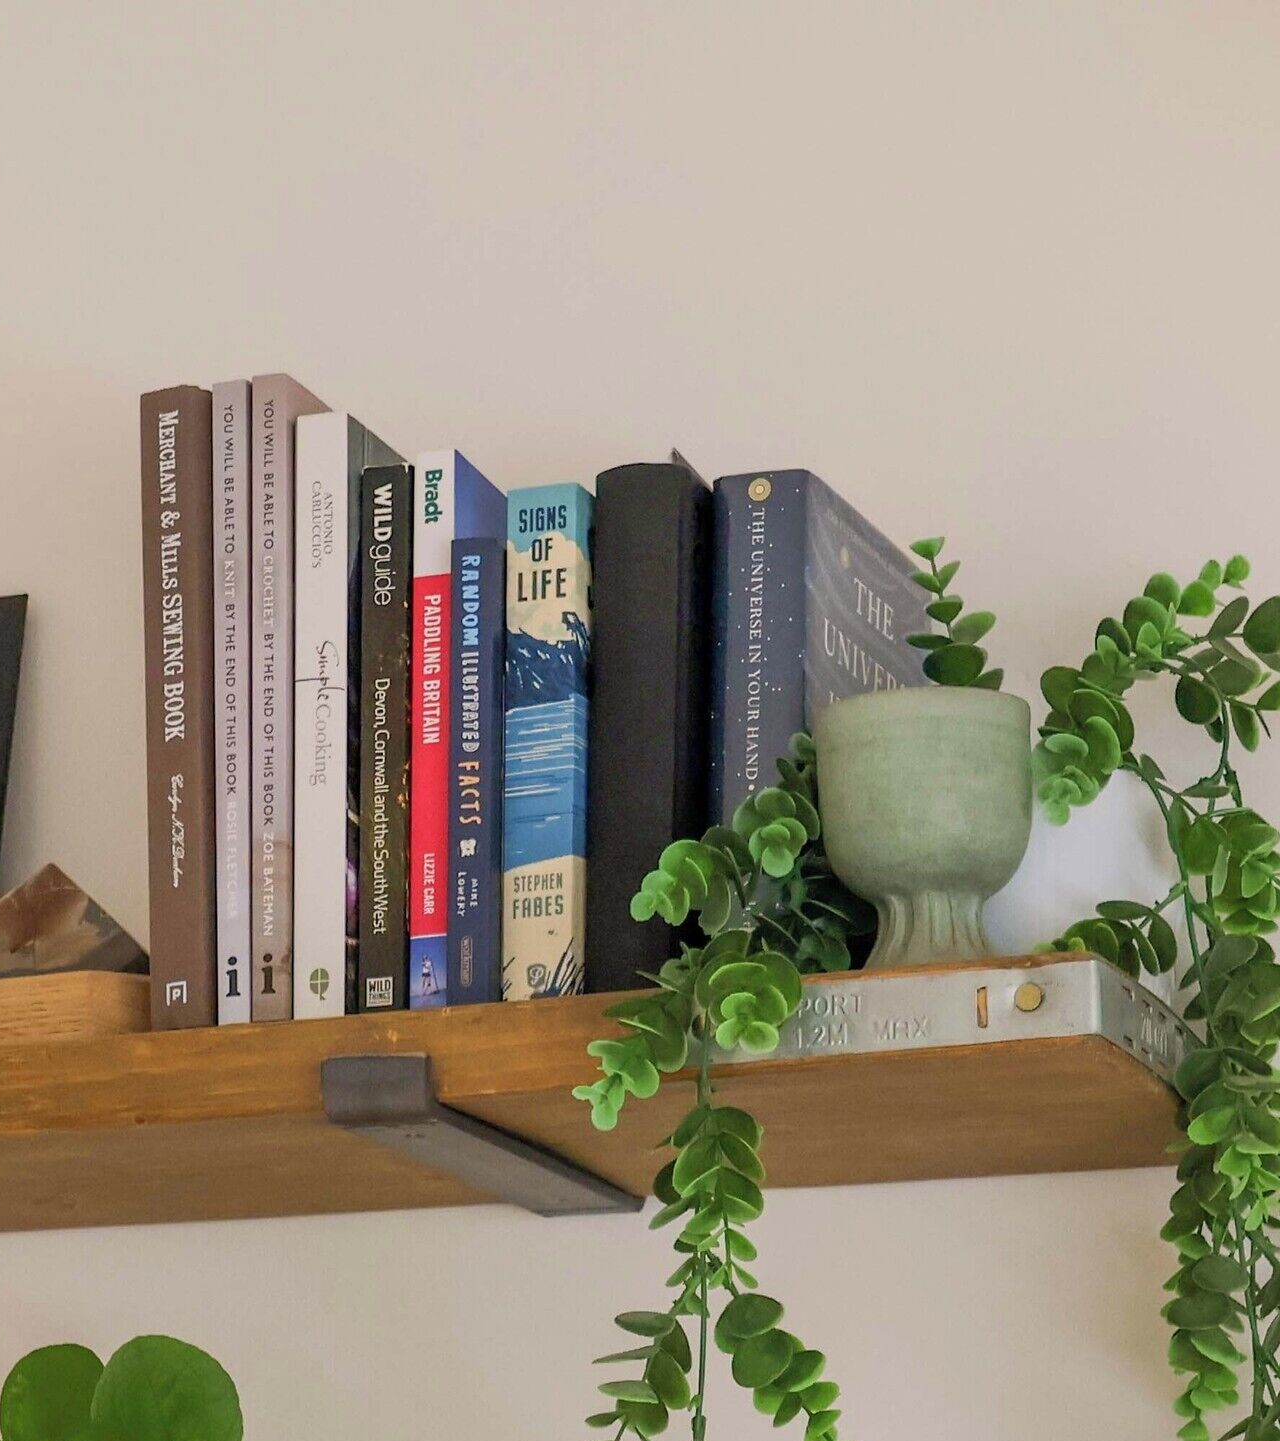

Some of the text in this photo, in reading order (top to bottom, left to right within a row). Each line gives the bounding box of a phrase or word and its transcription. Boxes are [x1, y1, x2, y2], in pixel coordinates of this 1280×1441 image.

[312, 481, 322, 569] CARLUCCIO'S
[323, 491, 334, 556] ANTONIO
[425, 469, 443, 524] Bradt
[519, 504, 567, 533] SIGNS
[159, 409, 185, 743] MERCHANT & MILLS SEWING BOOK
[531, 538, 554, 562] OF
[223, 404, 237, 796] YOU WILL BE ABLE TO KNIT BY THE END OF THIS BOOK
[263, 399, 274, 826] YOU WILL BE ABLE TO CROCHET BY THE END OF THIS BOOK
[517, 568, 567, 602] LIFE
[853, 577, 894, 641] THE
[422, 594, 442, 745] PADDLING BRITAIN
[745, 508, 765, 781] THE UNIVERSE IN YOUR HAND
[458, 555, 482, 825] RANDOM ILLUSTRATED FACTS
[309, 703, 333, 787] Cooking
[373, 678, 390, 935] Devon, Cornwall and the South West
[263, 833, 274, 936] ZOE BATEMAN
[423, 853, 435, 915] LIZZIE CARR
[457, 871, 468, 917] LOWERY
[470, 878, 479, 908] MIKE
[512, 895, 564, 919] FABES
[513, 872, 563, 893] STEPHEN
[368, 979, 391, 992] WILD
[797, 993, 864, 1019] PORT
